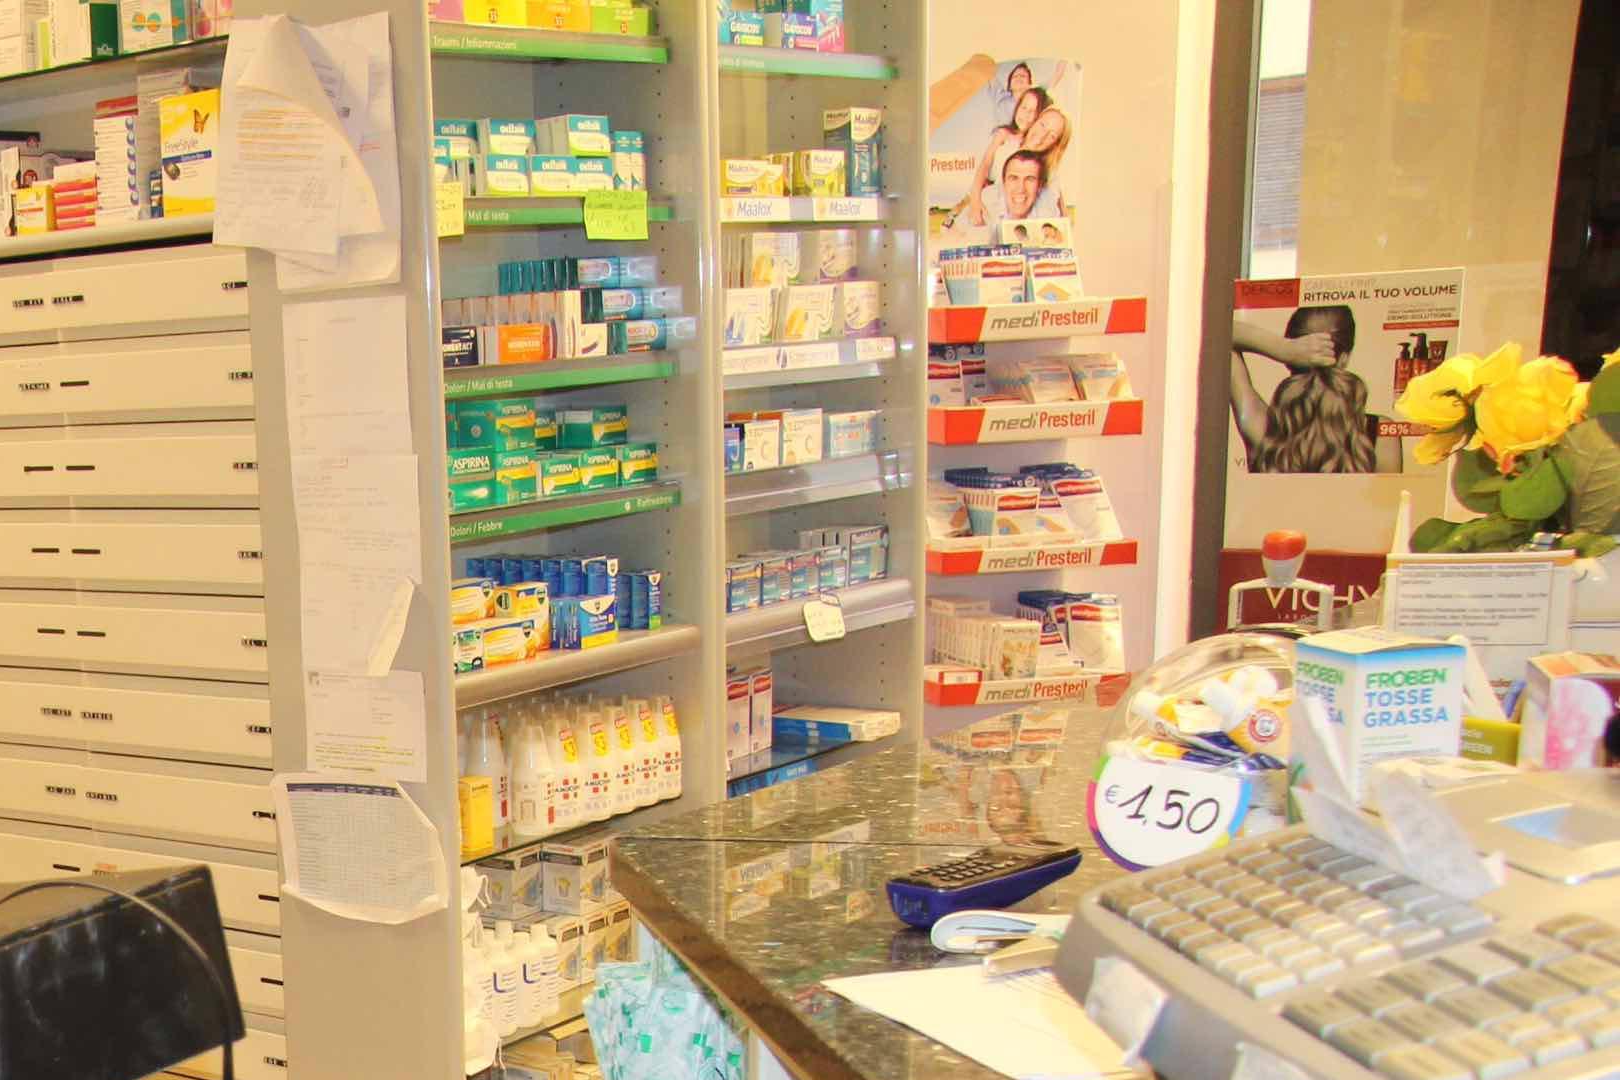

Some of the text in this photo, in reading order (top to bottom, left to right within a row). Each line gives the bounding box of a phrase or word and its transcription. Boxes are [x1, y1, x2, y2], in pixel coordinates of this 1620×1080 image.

[931, 157, 975, 173] Presteril
[1303, 284, 1457, 302] RITROVA IL TUO VOLUME
[1041, 307, 1099, 326] Presteril
[1040, 409, 1095, 428] Presteril
[1380, 424, 1409, 435] 96%
[453, 456, 490, 471] ASPIRINA
[1037, 548, 1092, 566] Presteril
[1366, 668, 1447, 690] FROBEN
[1033, 681, 1088, 697] Presteril
[1364, 688, 1433, 708] TOSSE
[1364, 706, 1449, 728] GRASSA
